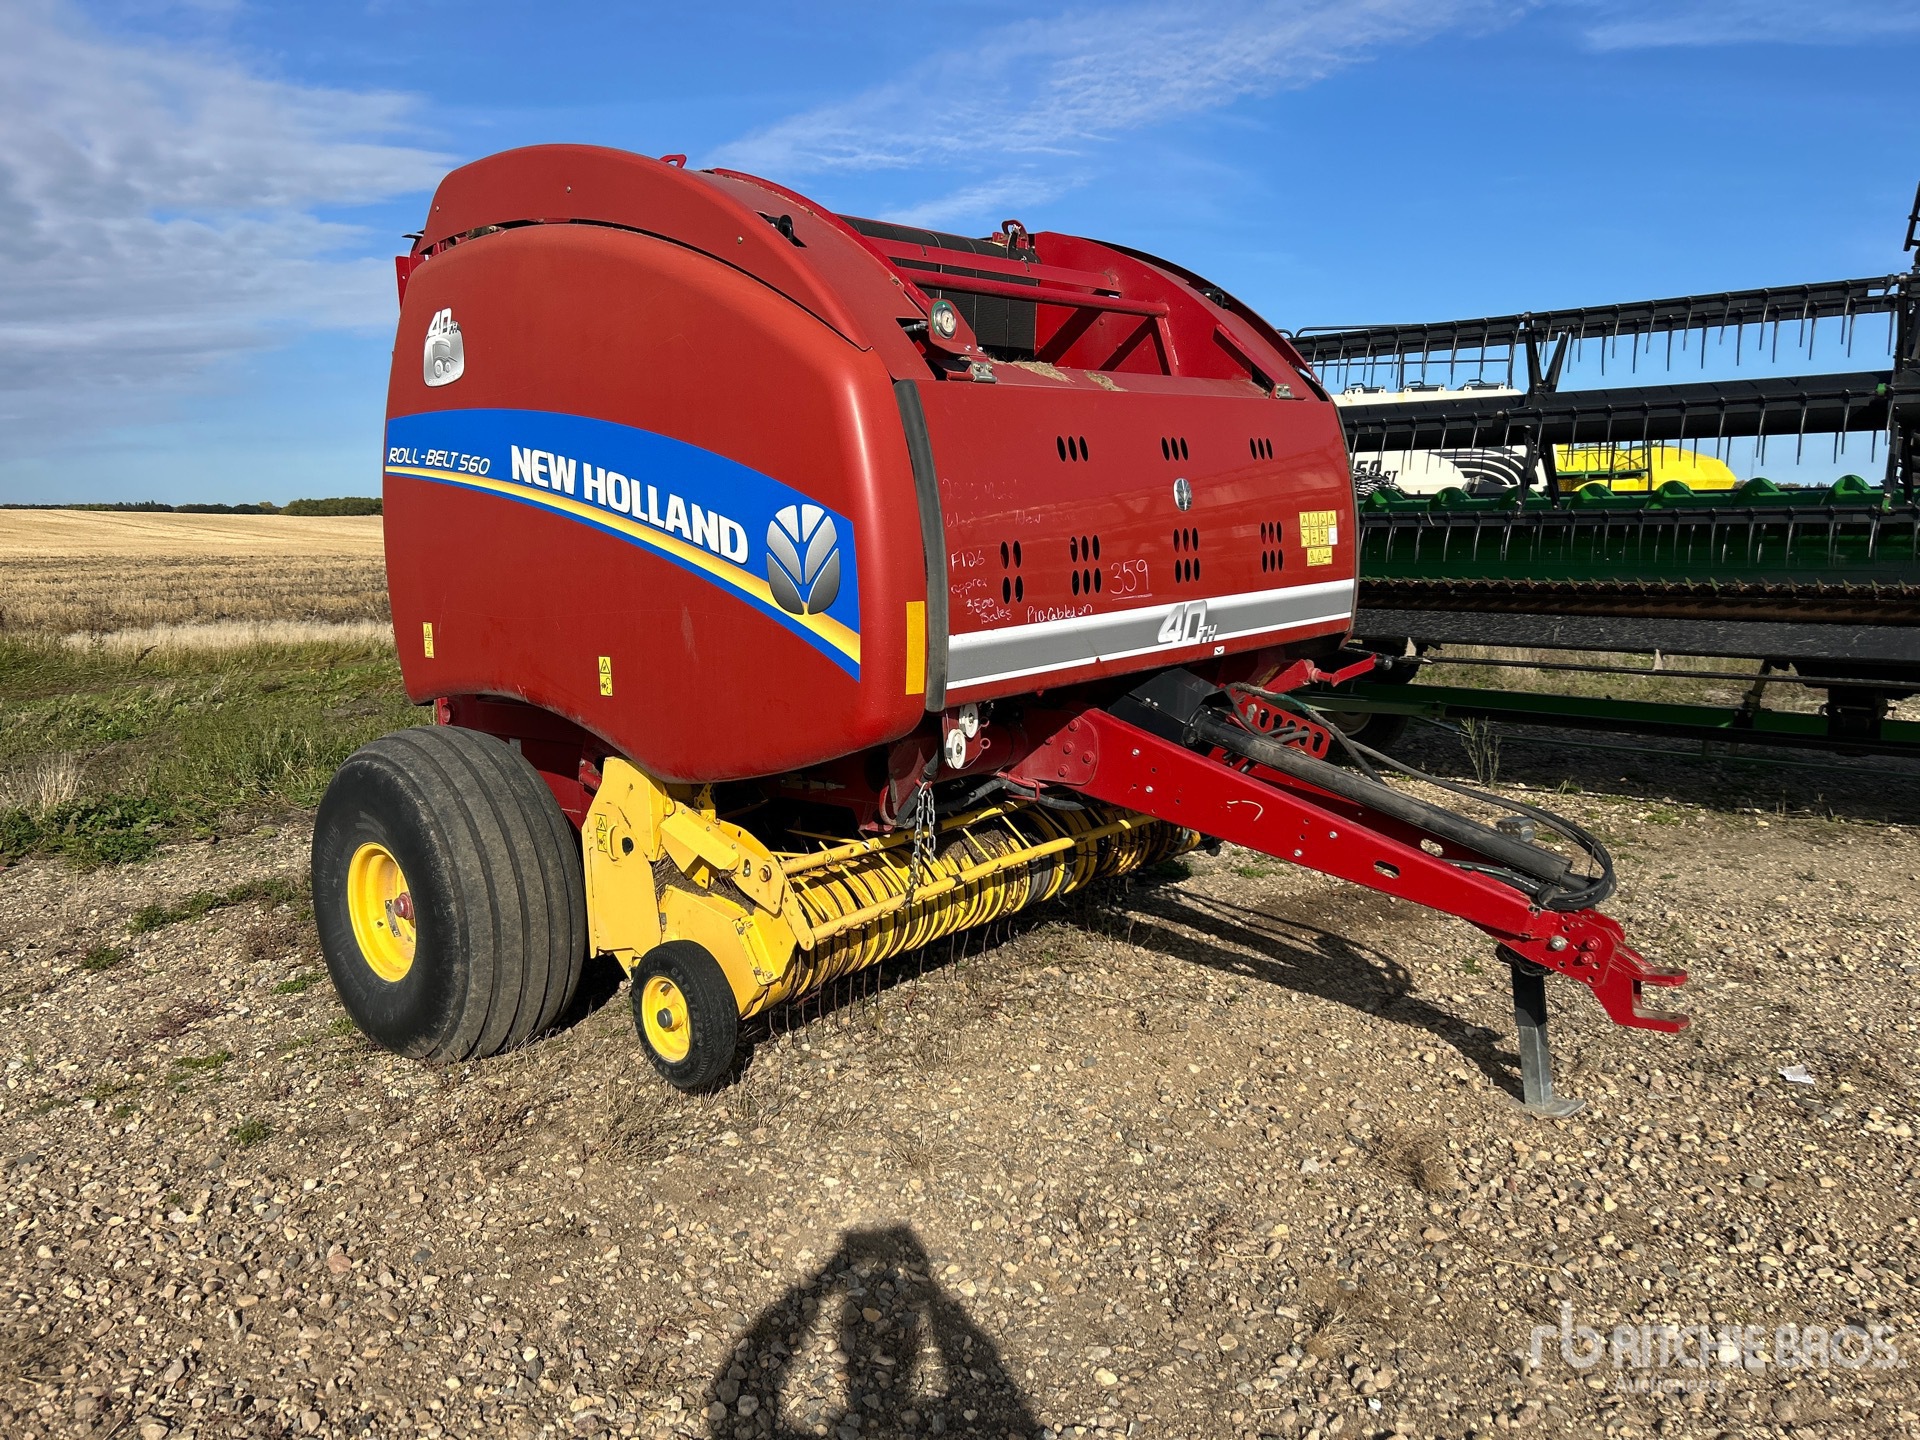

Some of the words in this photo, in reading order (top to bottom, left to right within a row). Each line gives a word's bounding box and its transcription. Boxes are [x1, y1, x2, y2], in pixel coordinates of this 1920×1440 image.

[388, 447, 458, 469] ROLL-BELT
[457, 454, 491, 475] 560
[511, 445, 577, 495] NEW
[583, 462, 749, 565] HOLLAND
[1110, 559, 1149, 595] 359
[966, 597, 995, 615] 3500
